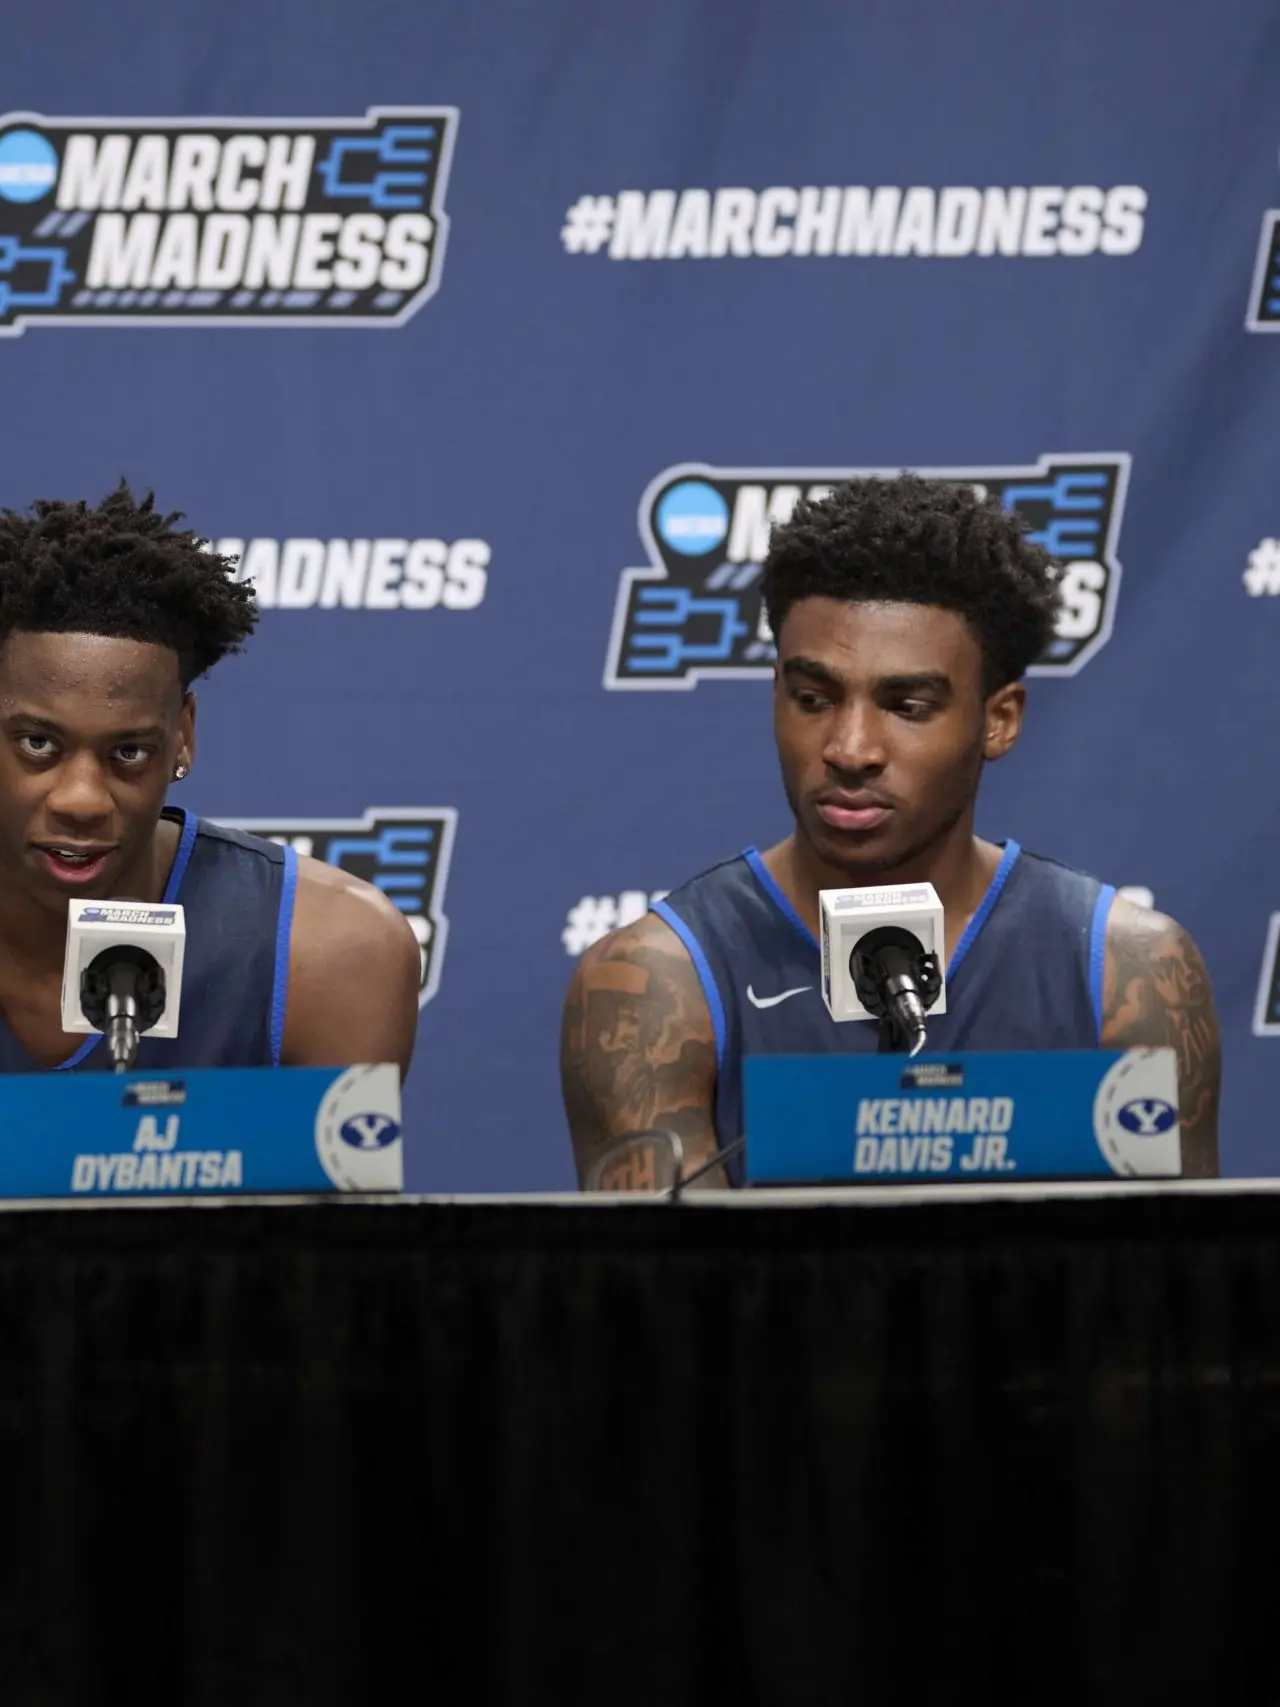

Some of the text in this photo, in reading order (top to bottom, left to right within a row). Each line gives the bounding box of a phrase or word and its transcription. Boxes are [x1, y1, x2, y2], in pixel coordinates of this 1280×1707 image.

[55, 134, 317, 211] MARCH
[560, 185, 1148, 260] #MARCHMADNESS
[85, 212, 434, 290] MADNESS
[133, 1115, 180, 1151] AJ
[856, 1097, 1014, 1135] KENNARD
[71, 1150, 243, 1192] DYBANTSA
[854, 1135, 1017, 1173] DAVIS JR.
